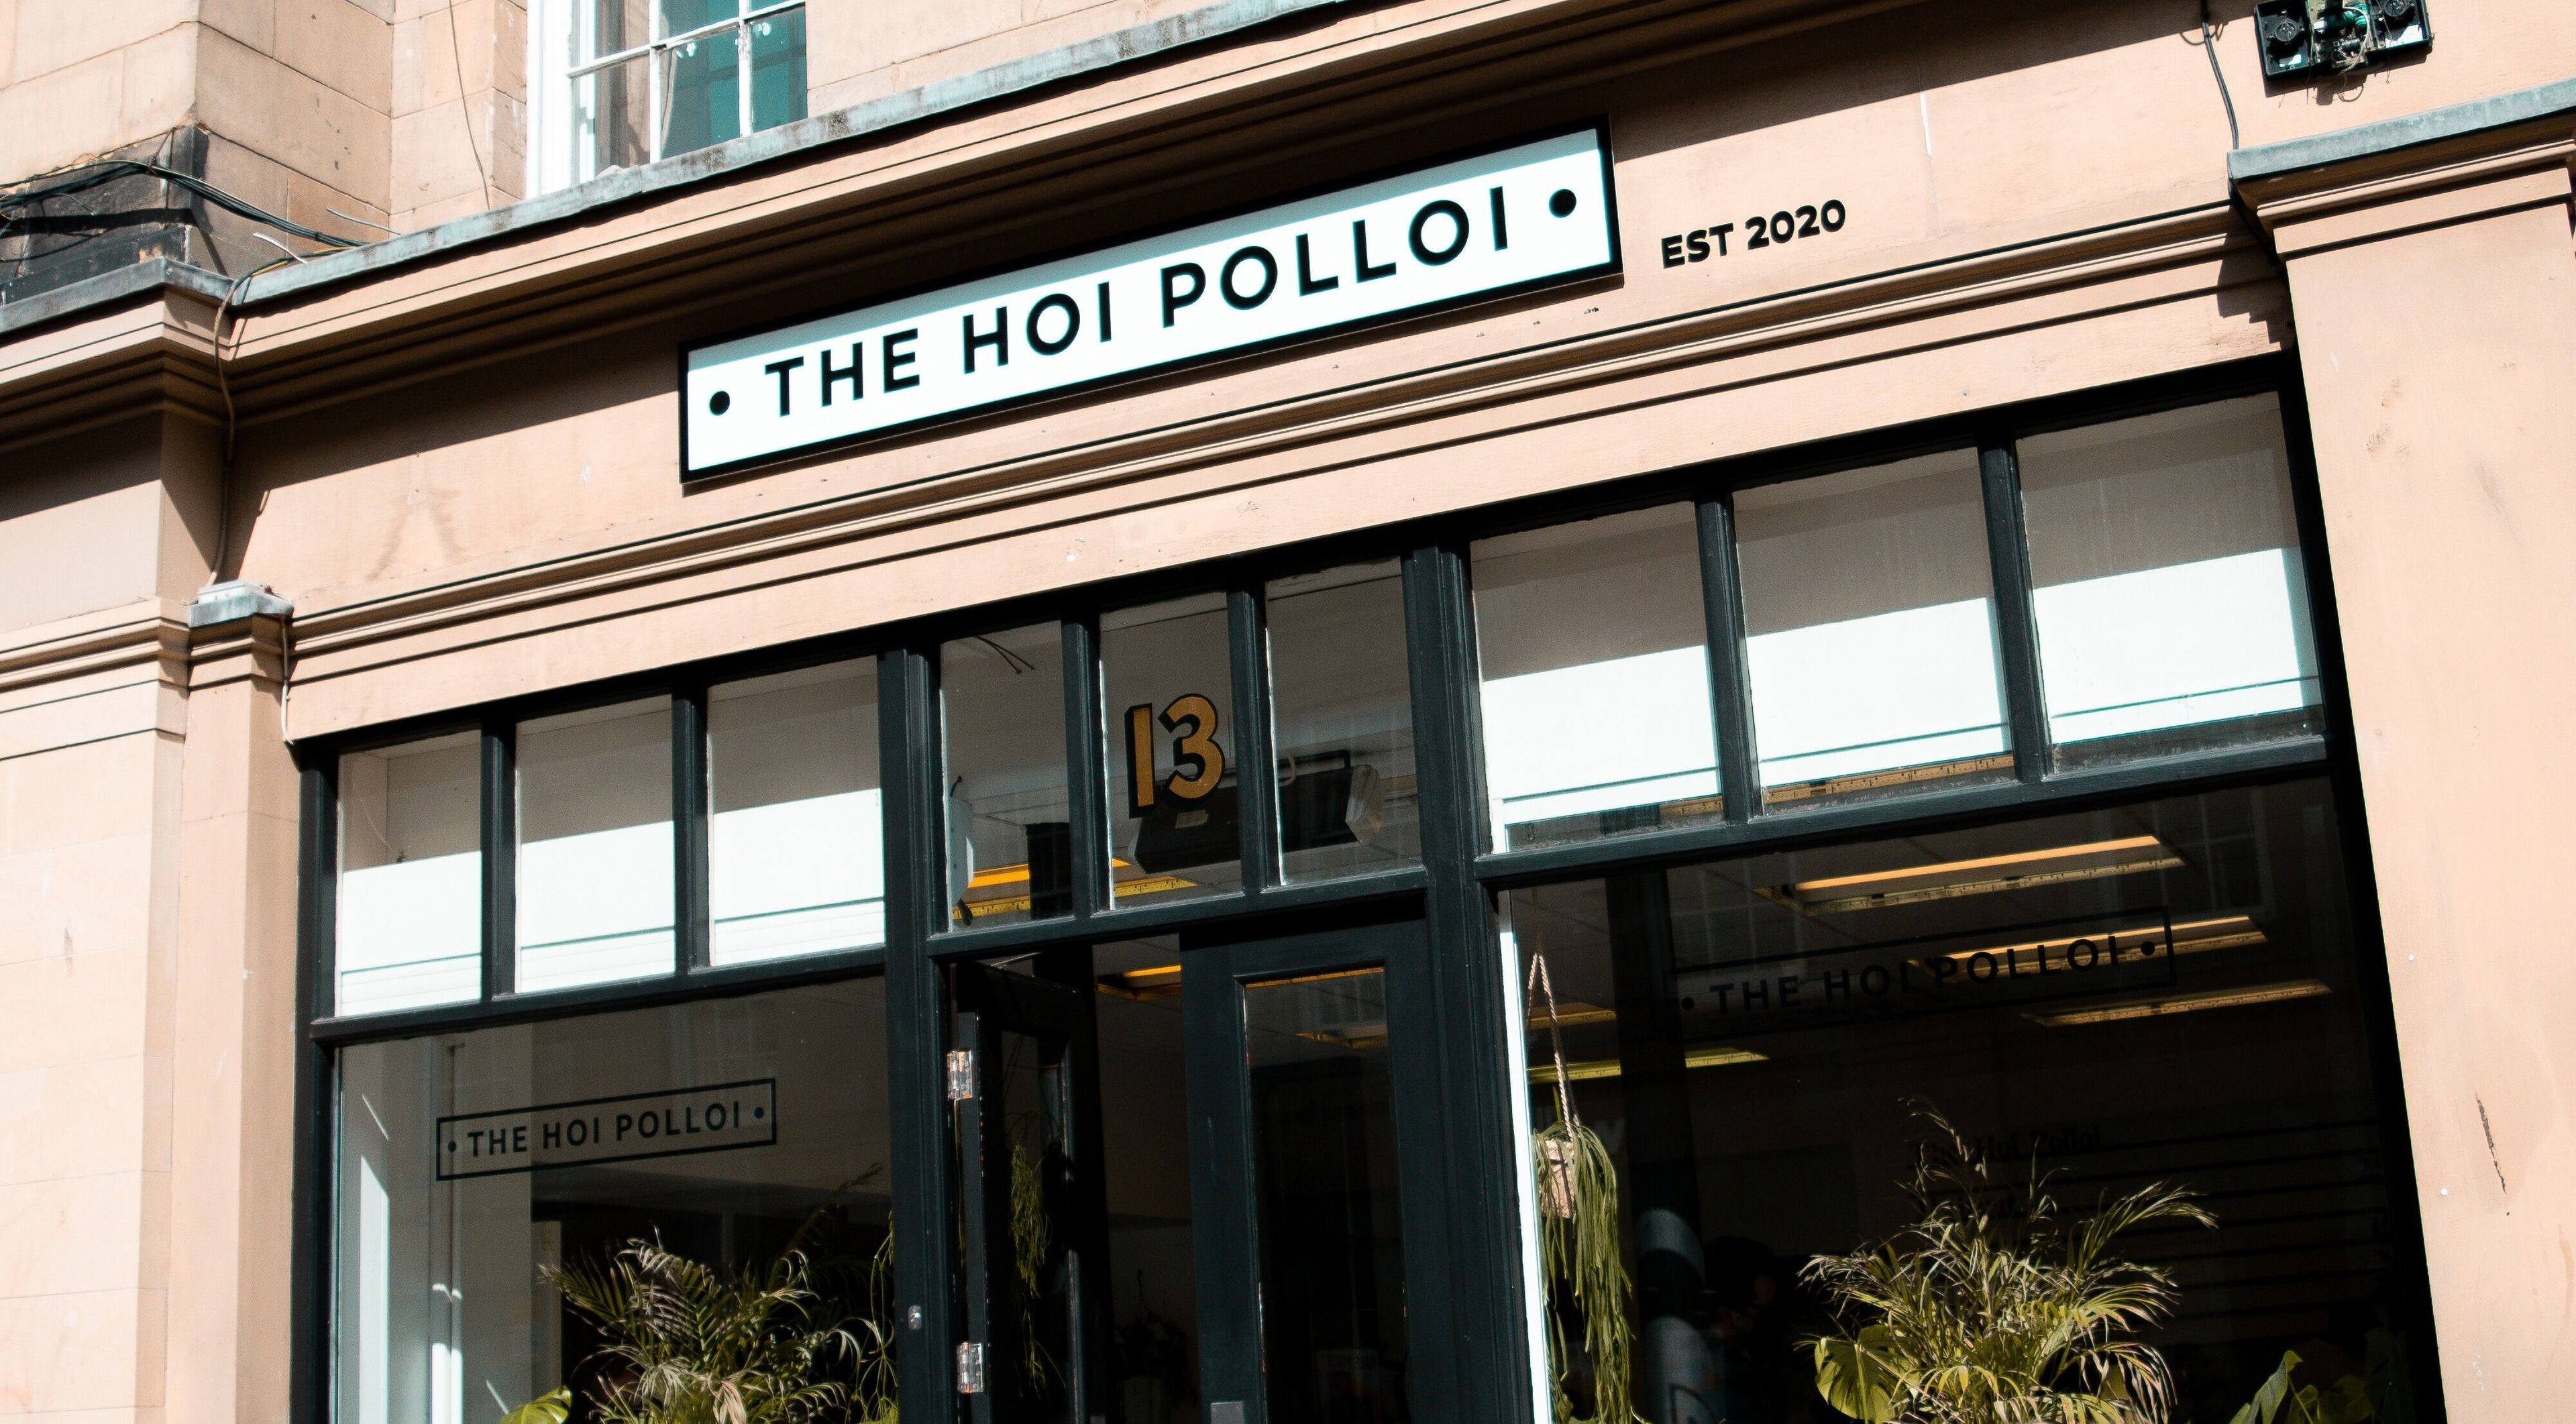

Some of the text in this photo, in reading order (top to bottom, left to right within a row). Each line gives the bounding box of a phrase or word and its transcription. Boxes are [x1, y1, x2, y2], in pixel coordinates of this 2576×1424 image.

[1661, 199, 1845, 269] EST 2020
[765, 185, 1508, 417] THE HOI POLLOI
[1124, 693, 1226, 820] 13
[1709, 934, 2119, 1016] THE HOI POLLOI
[467, 1101, 740, 1158] THE HOI POLLOI
